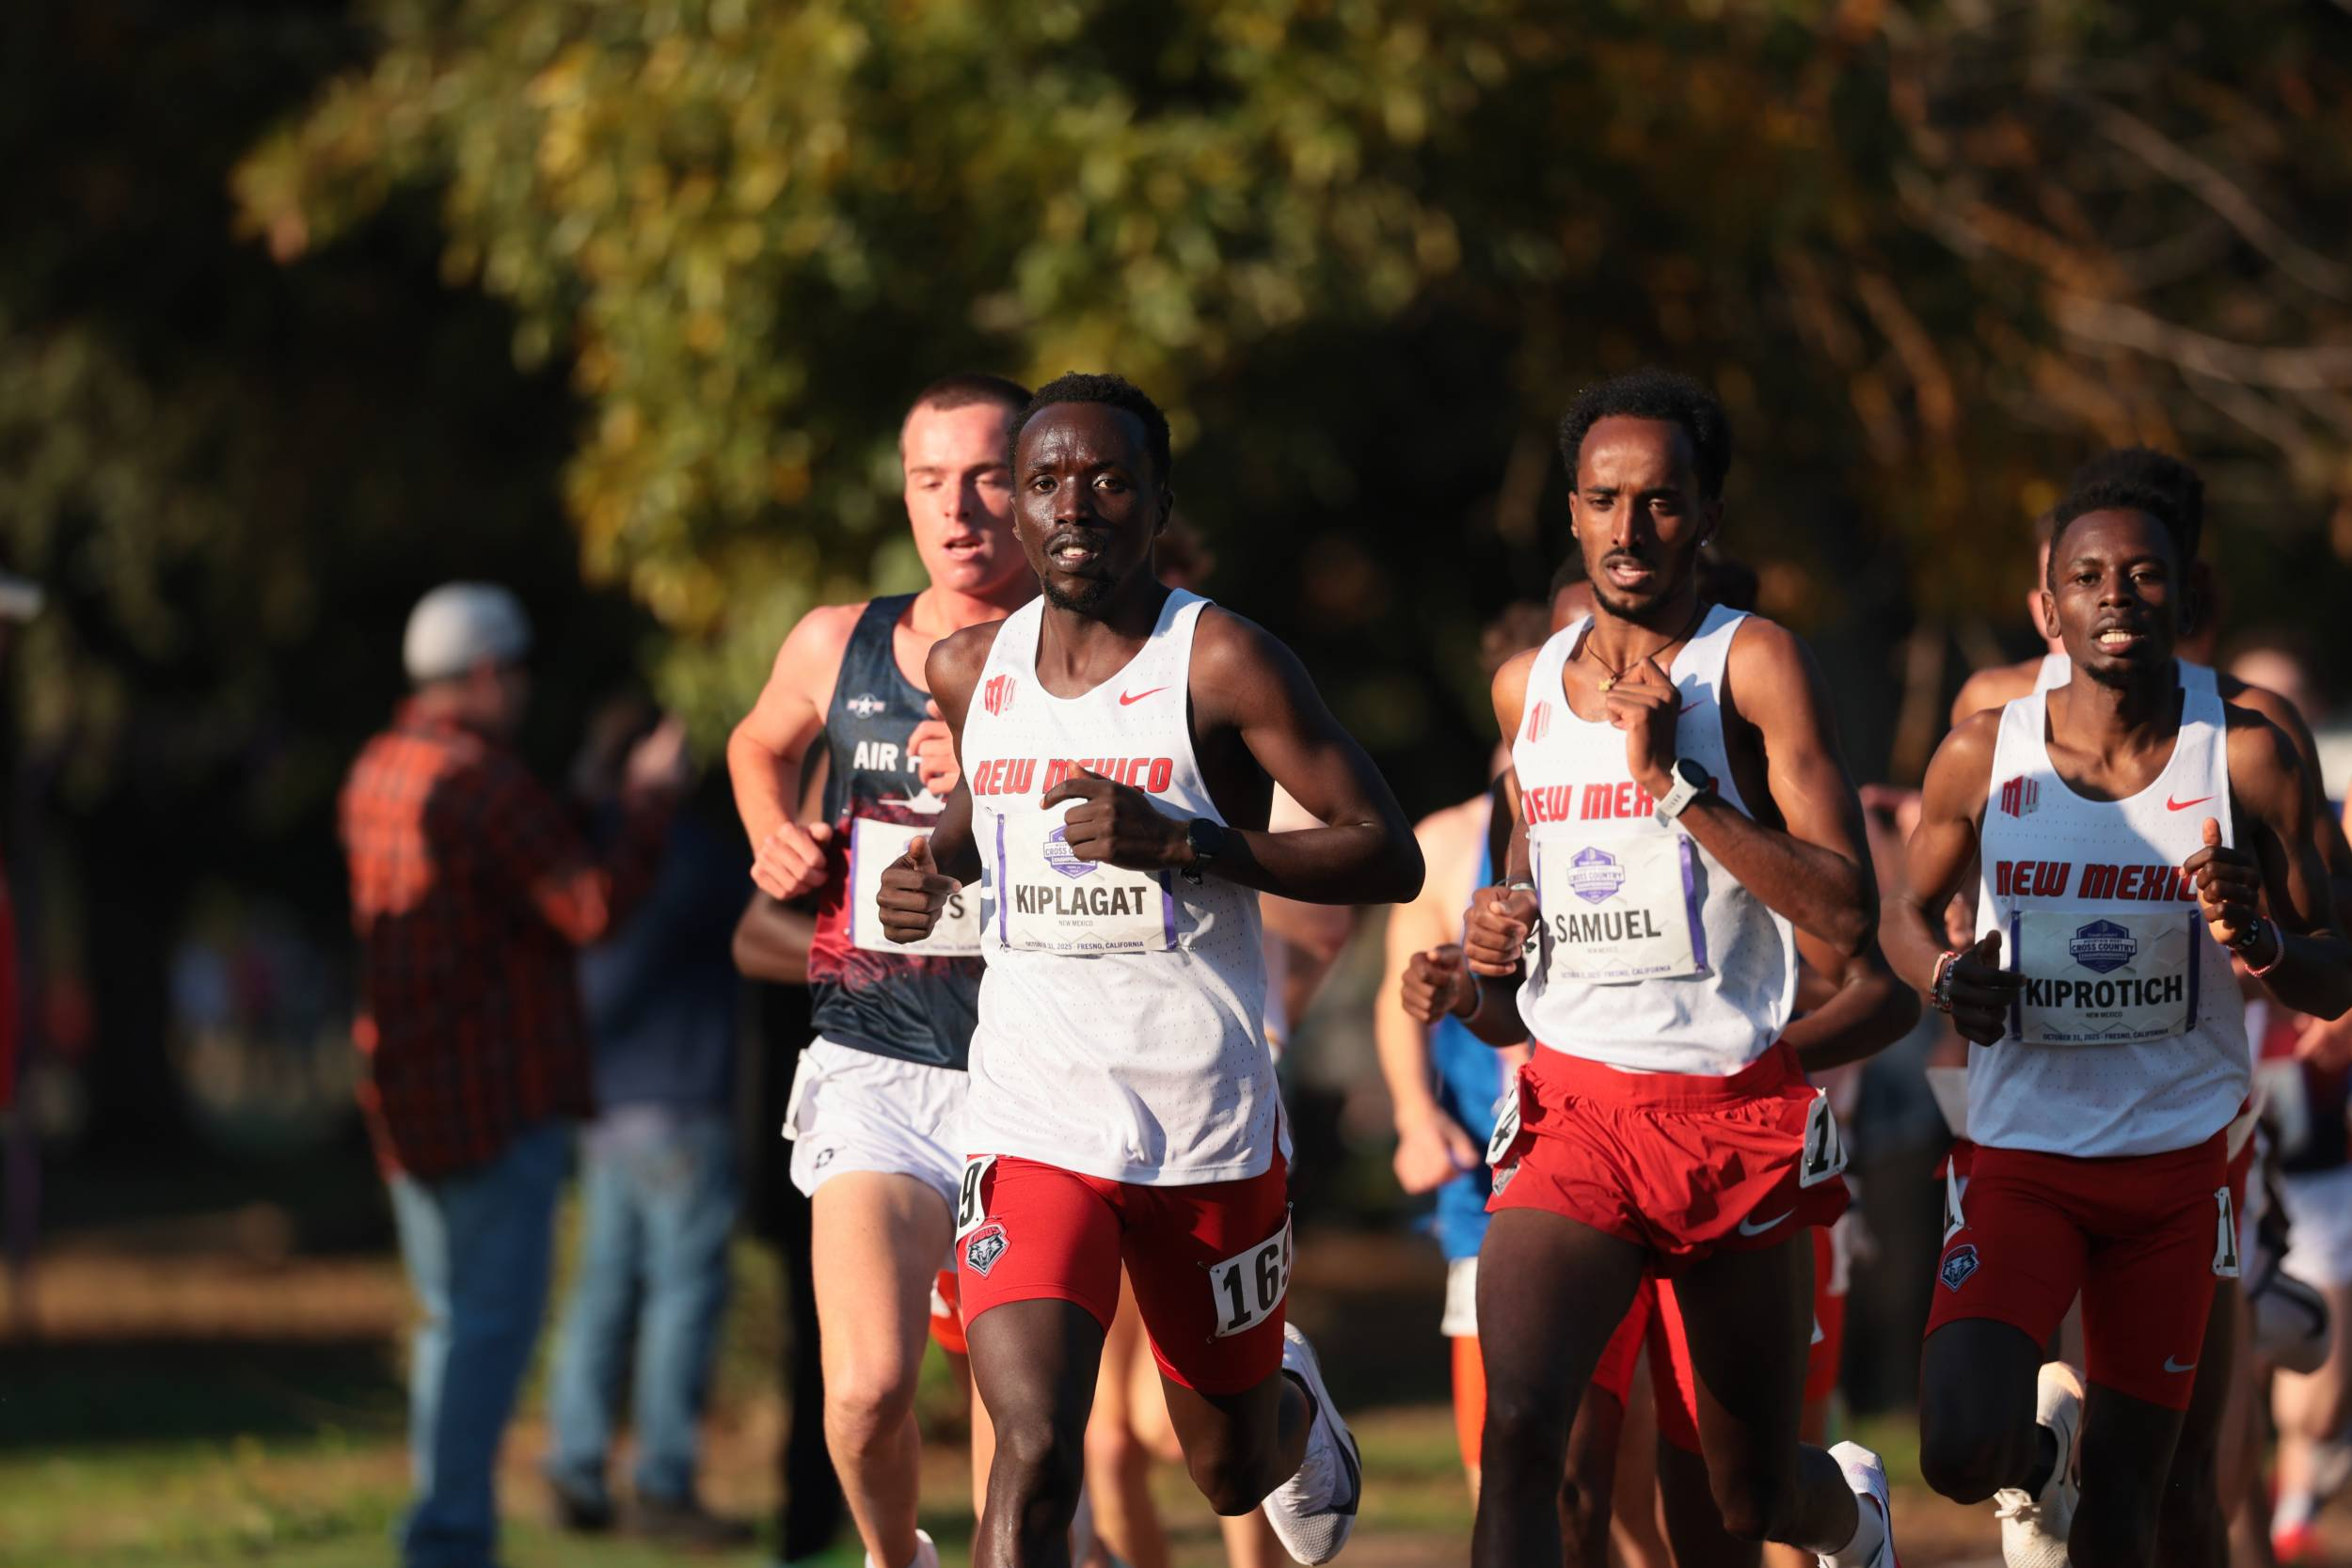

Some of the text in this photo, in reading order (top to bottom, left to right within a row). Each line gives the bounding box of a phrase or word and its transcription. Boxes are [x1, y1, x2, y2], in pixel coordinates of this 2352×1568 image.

[853, 740, 899, 771] AIR
[973, 758, 1037, 796] NEW
[1995, 861, 2198, 902] NEW MEXIC
[1015, 884, 1147, 916] KIPLAGAT
[1556, 909, 1661, 943] SAMUEL
[1104, 941, 1144, 949] CALIFORNIA
[2071, 942, 2135, 952] CROSS COUNTRY
[1631, 964, 1671, 975] CALIFORNIA
[2026, 974, 2183, 1008] KIPROTICH
[2042, 1033, 2071, 1041] OCTOBER
[2133, 1028, 2169, 1039] CALIFORNIA
